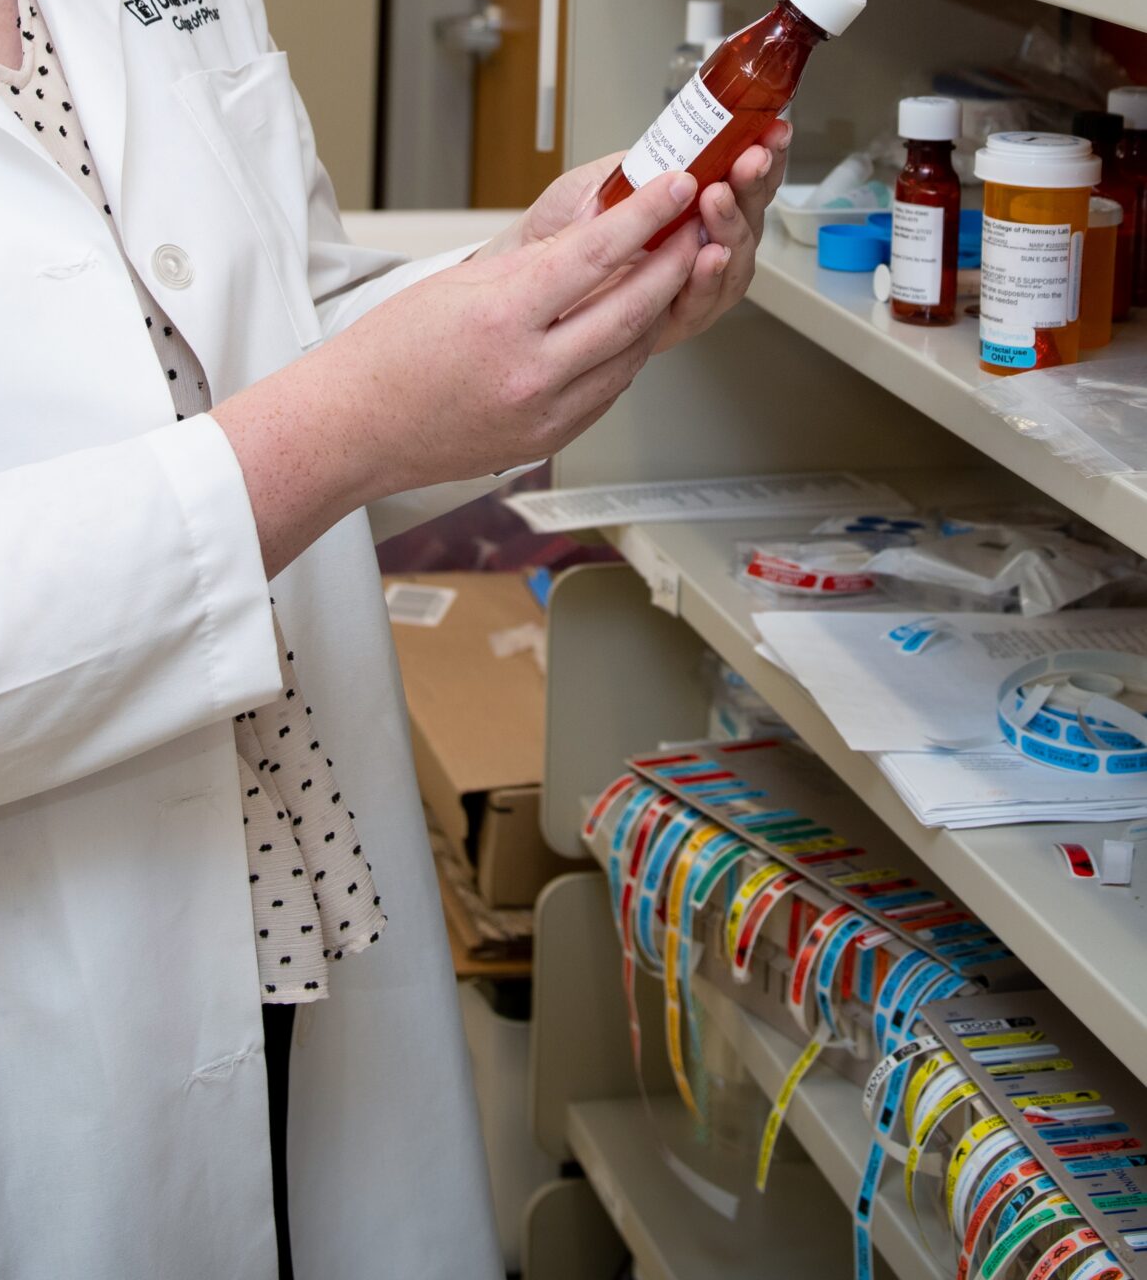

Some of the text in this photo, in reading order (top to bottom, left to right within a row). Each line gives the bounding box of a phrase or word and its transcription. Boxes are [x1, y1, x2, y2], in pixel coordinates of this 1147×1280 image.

[711, 106, 725, 121] Lab
[648, 147, 670, 171] HOURS
[992, 222, 1012, 233] College
[1022, 227, 1056, 235] Pharmacy
[998, 289, 1035, 300] suppository
[1051, 291, 1062, 299] the
[995, 297, 1018, 306] needed
[992, 345, 1011, 354] rectal
[991, 353, 1016, 363] ONLY
